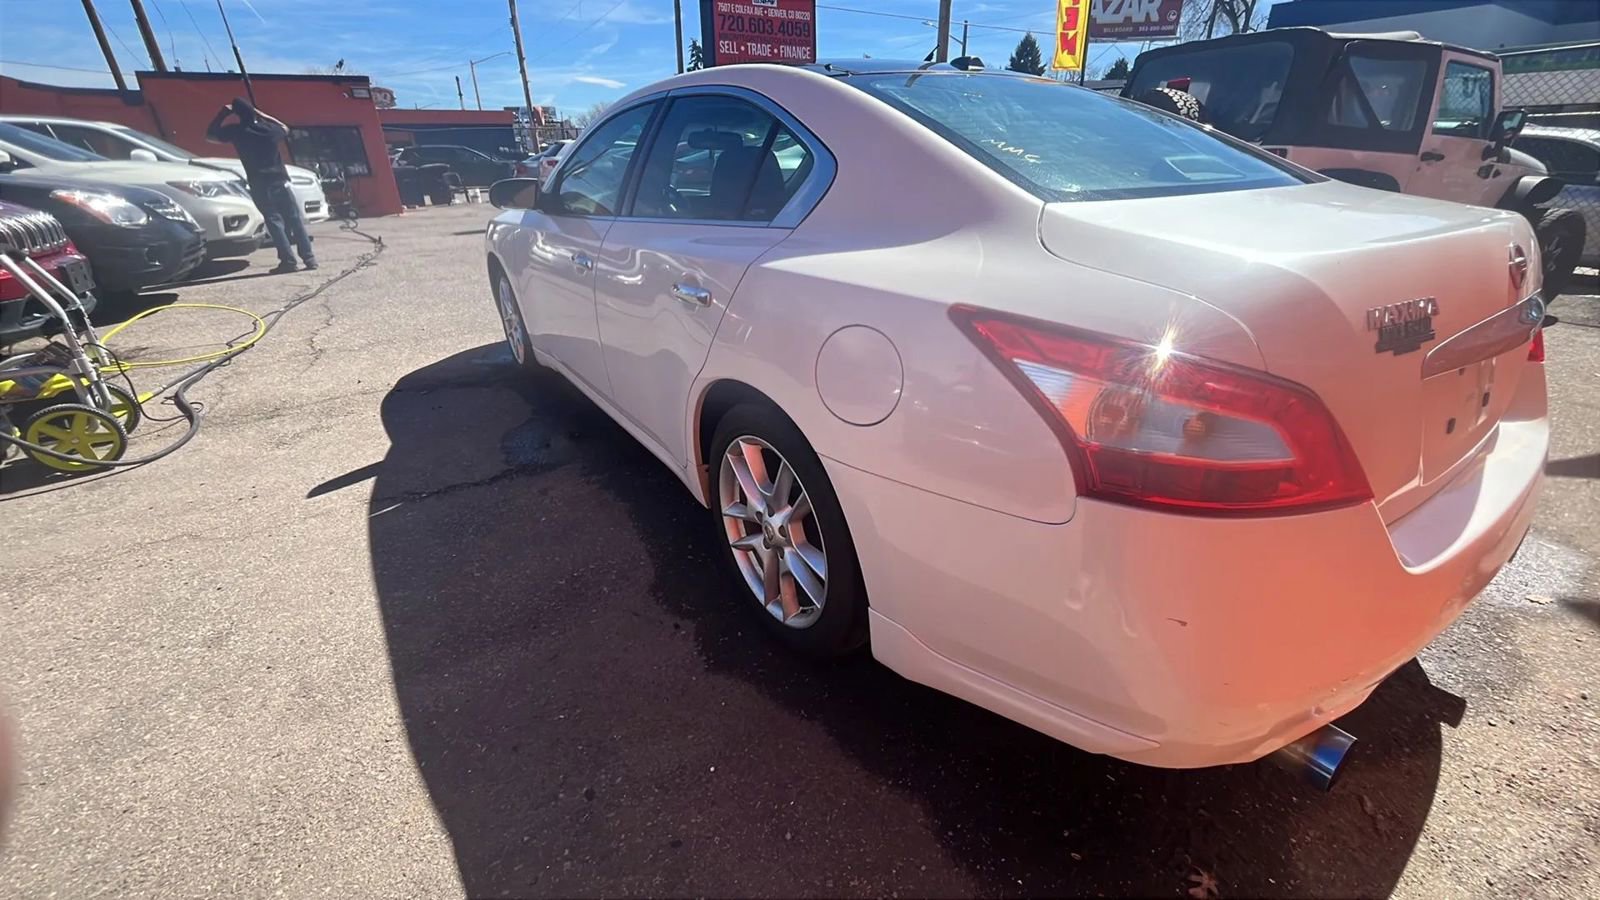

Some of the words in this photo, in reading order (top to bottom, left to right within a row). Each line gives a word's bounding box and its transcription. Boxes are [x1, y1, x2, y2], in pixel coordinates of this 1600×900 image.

[717, 2, 731, 12] 7507
[731, 4, 735, 13] E
[735, 4, 753, 15] COLFAX
[754, 6, 764, 16] AVE
[788, 10, 795, 19] CO
[795, 10, 811, 20] 80220
[719, 13, 811, 38] 720.603.4059
[719, 40, 739, 55] SELL
[746, 43, 772, 57] TRADE
[780, 45, 811, 60] FINANCE
[1366, 296, 1439, 332] MAXIMA
